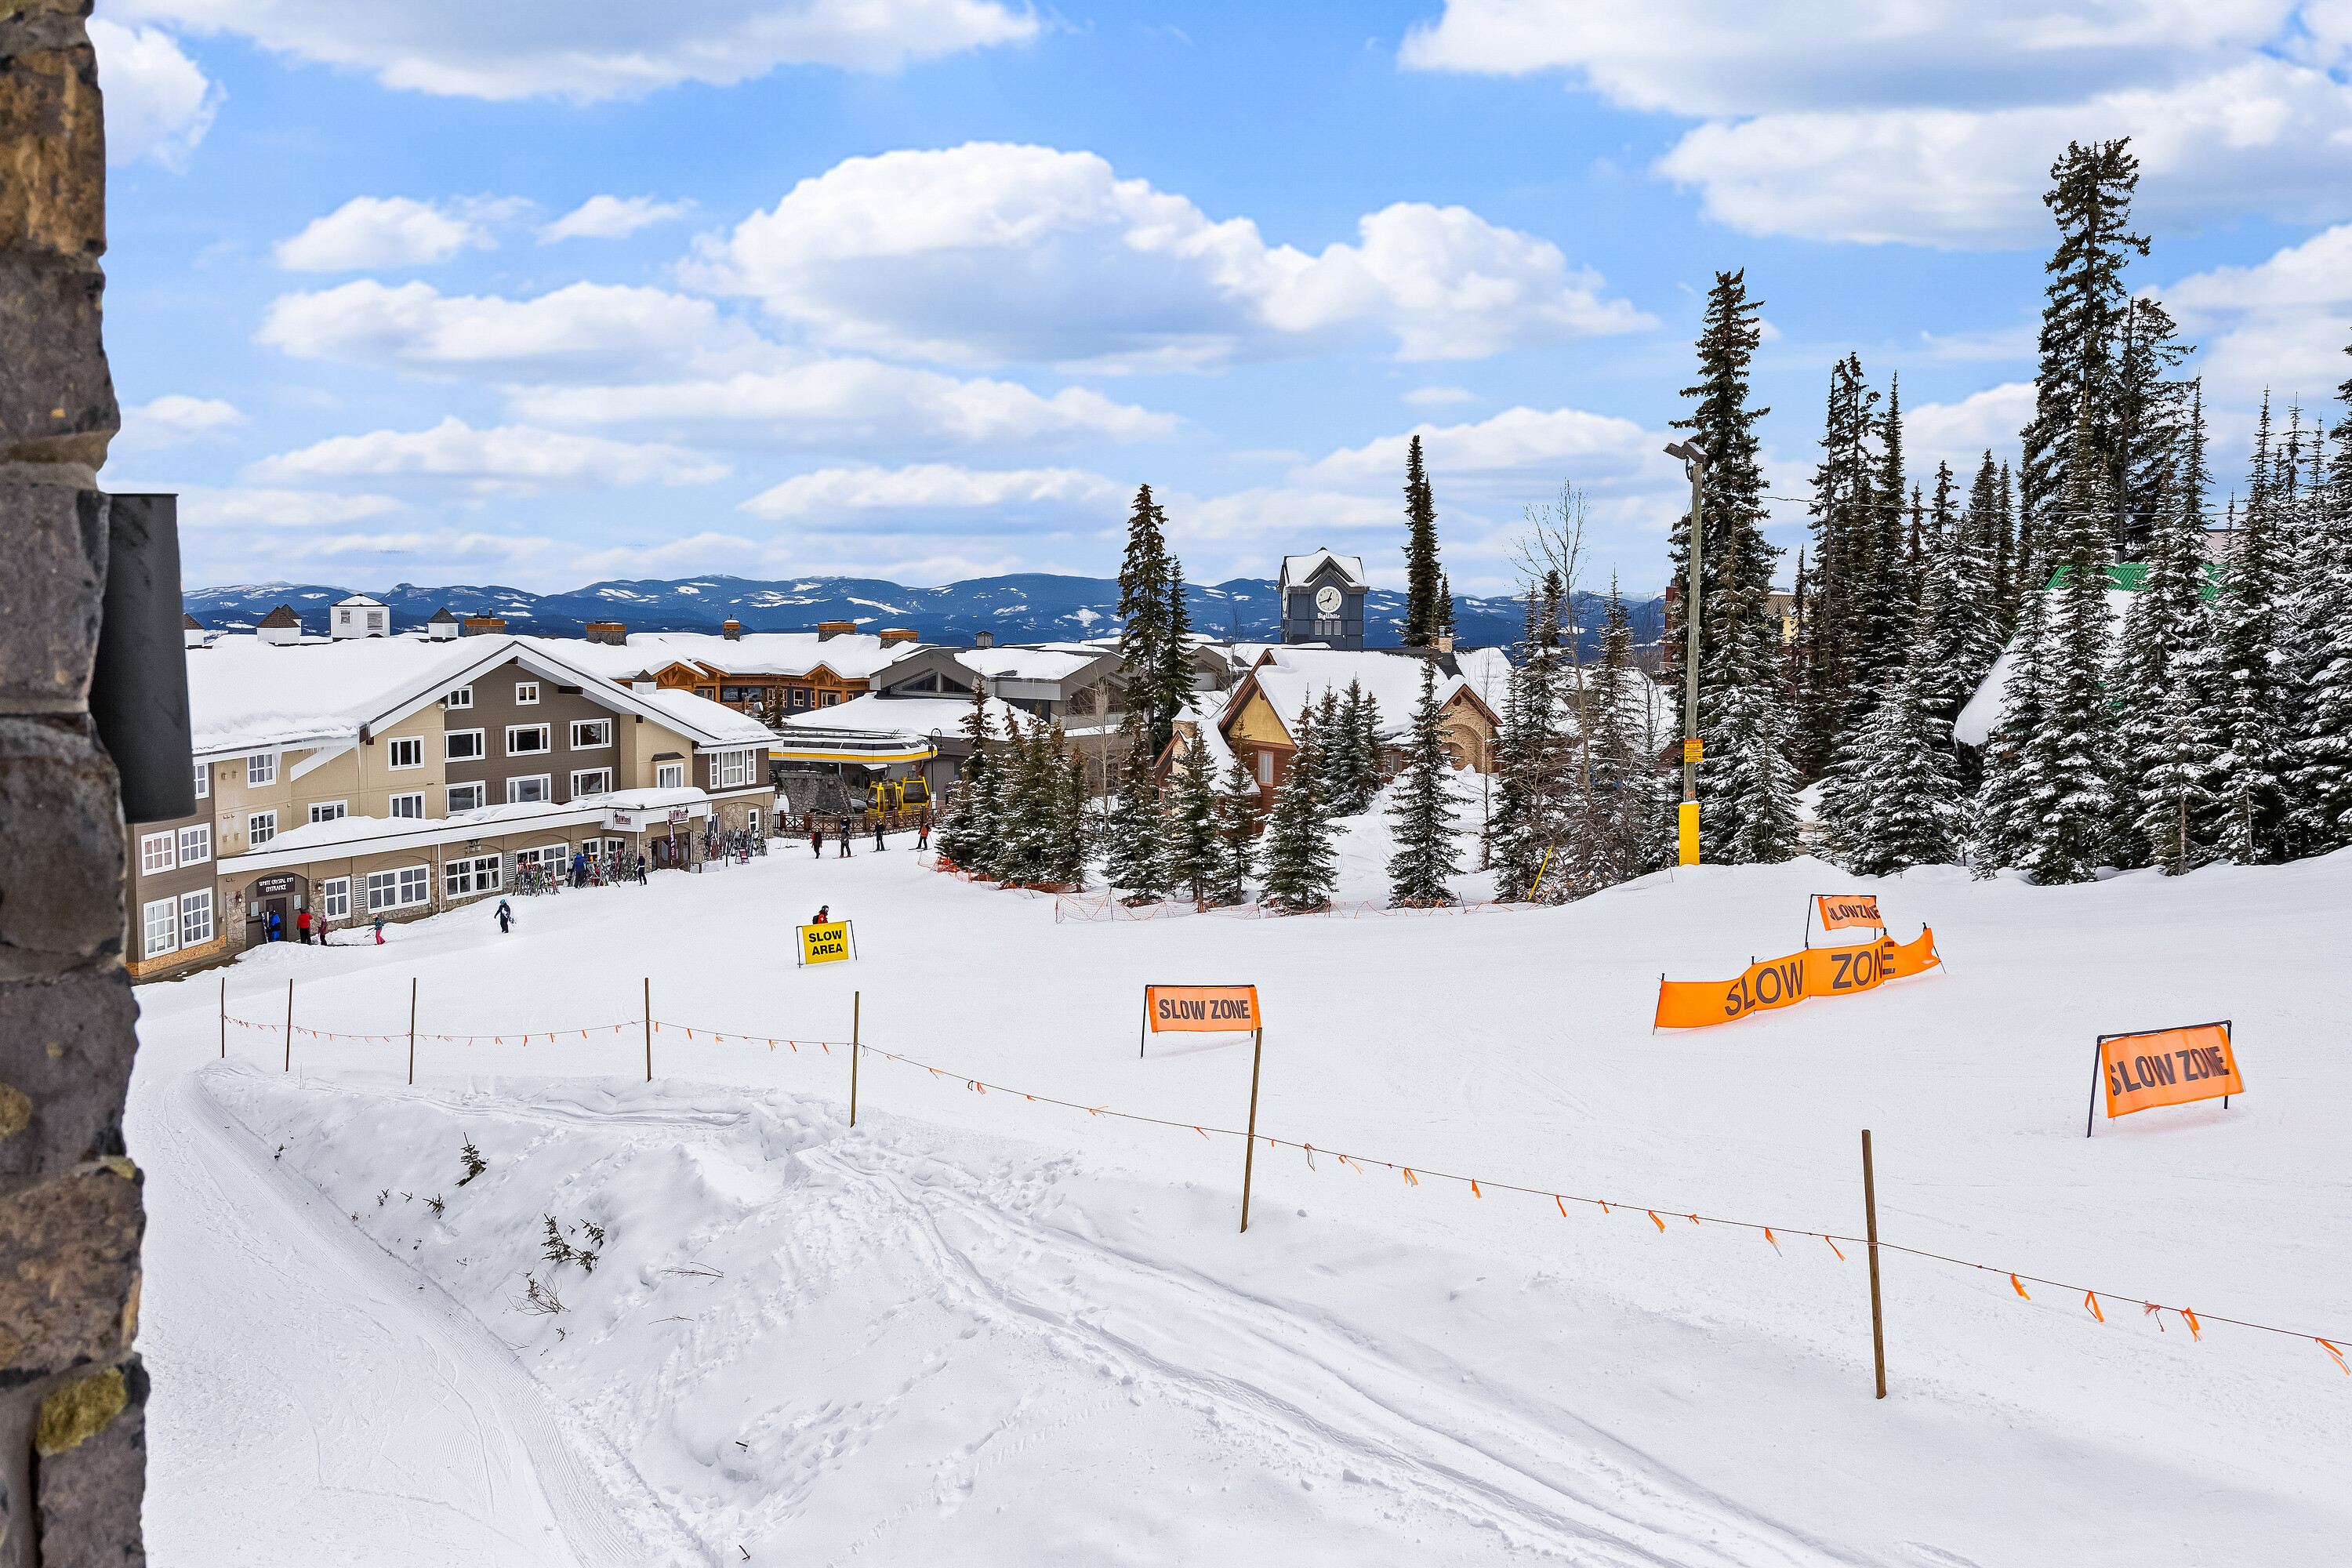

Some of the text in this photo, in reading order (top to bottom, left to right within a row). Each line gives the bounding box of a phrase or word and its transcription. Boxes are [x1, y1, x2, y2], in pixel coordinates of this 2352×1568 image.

[266, 884, 287, 893] ENTRANCE
[1828, 904, 1859, 920] LOW
[808, 930, 842, 942] SLOW
[811, 943, 843, 956] AREA
[1724, 941, 1896, 1016] SLOW ZONE
[1159, 999, 1250, 1019] SLOW ZONE
[2110, 1046, 2230, 1096] SLOW ZONE
